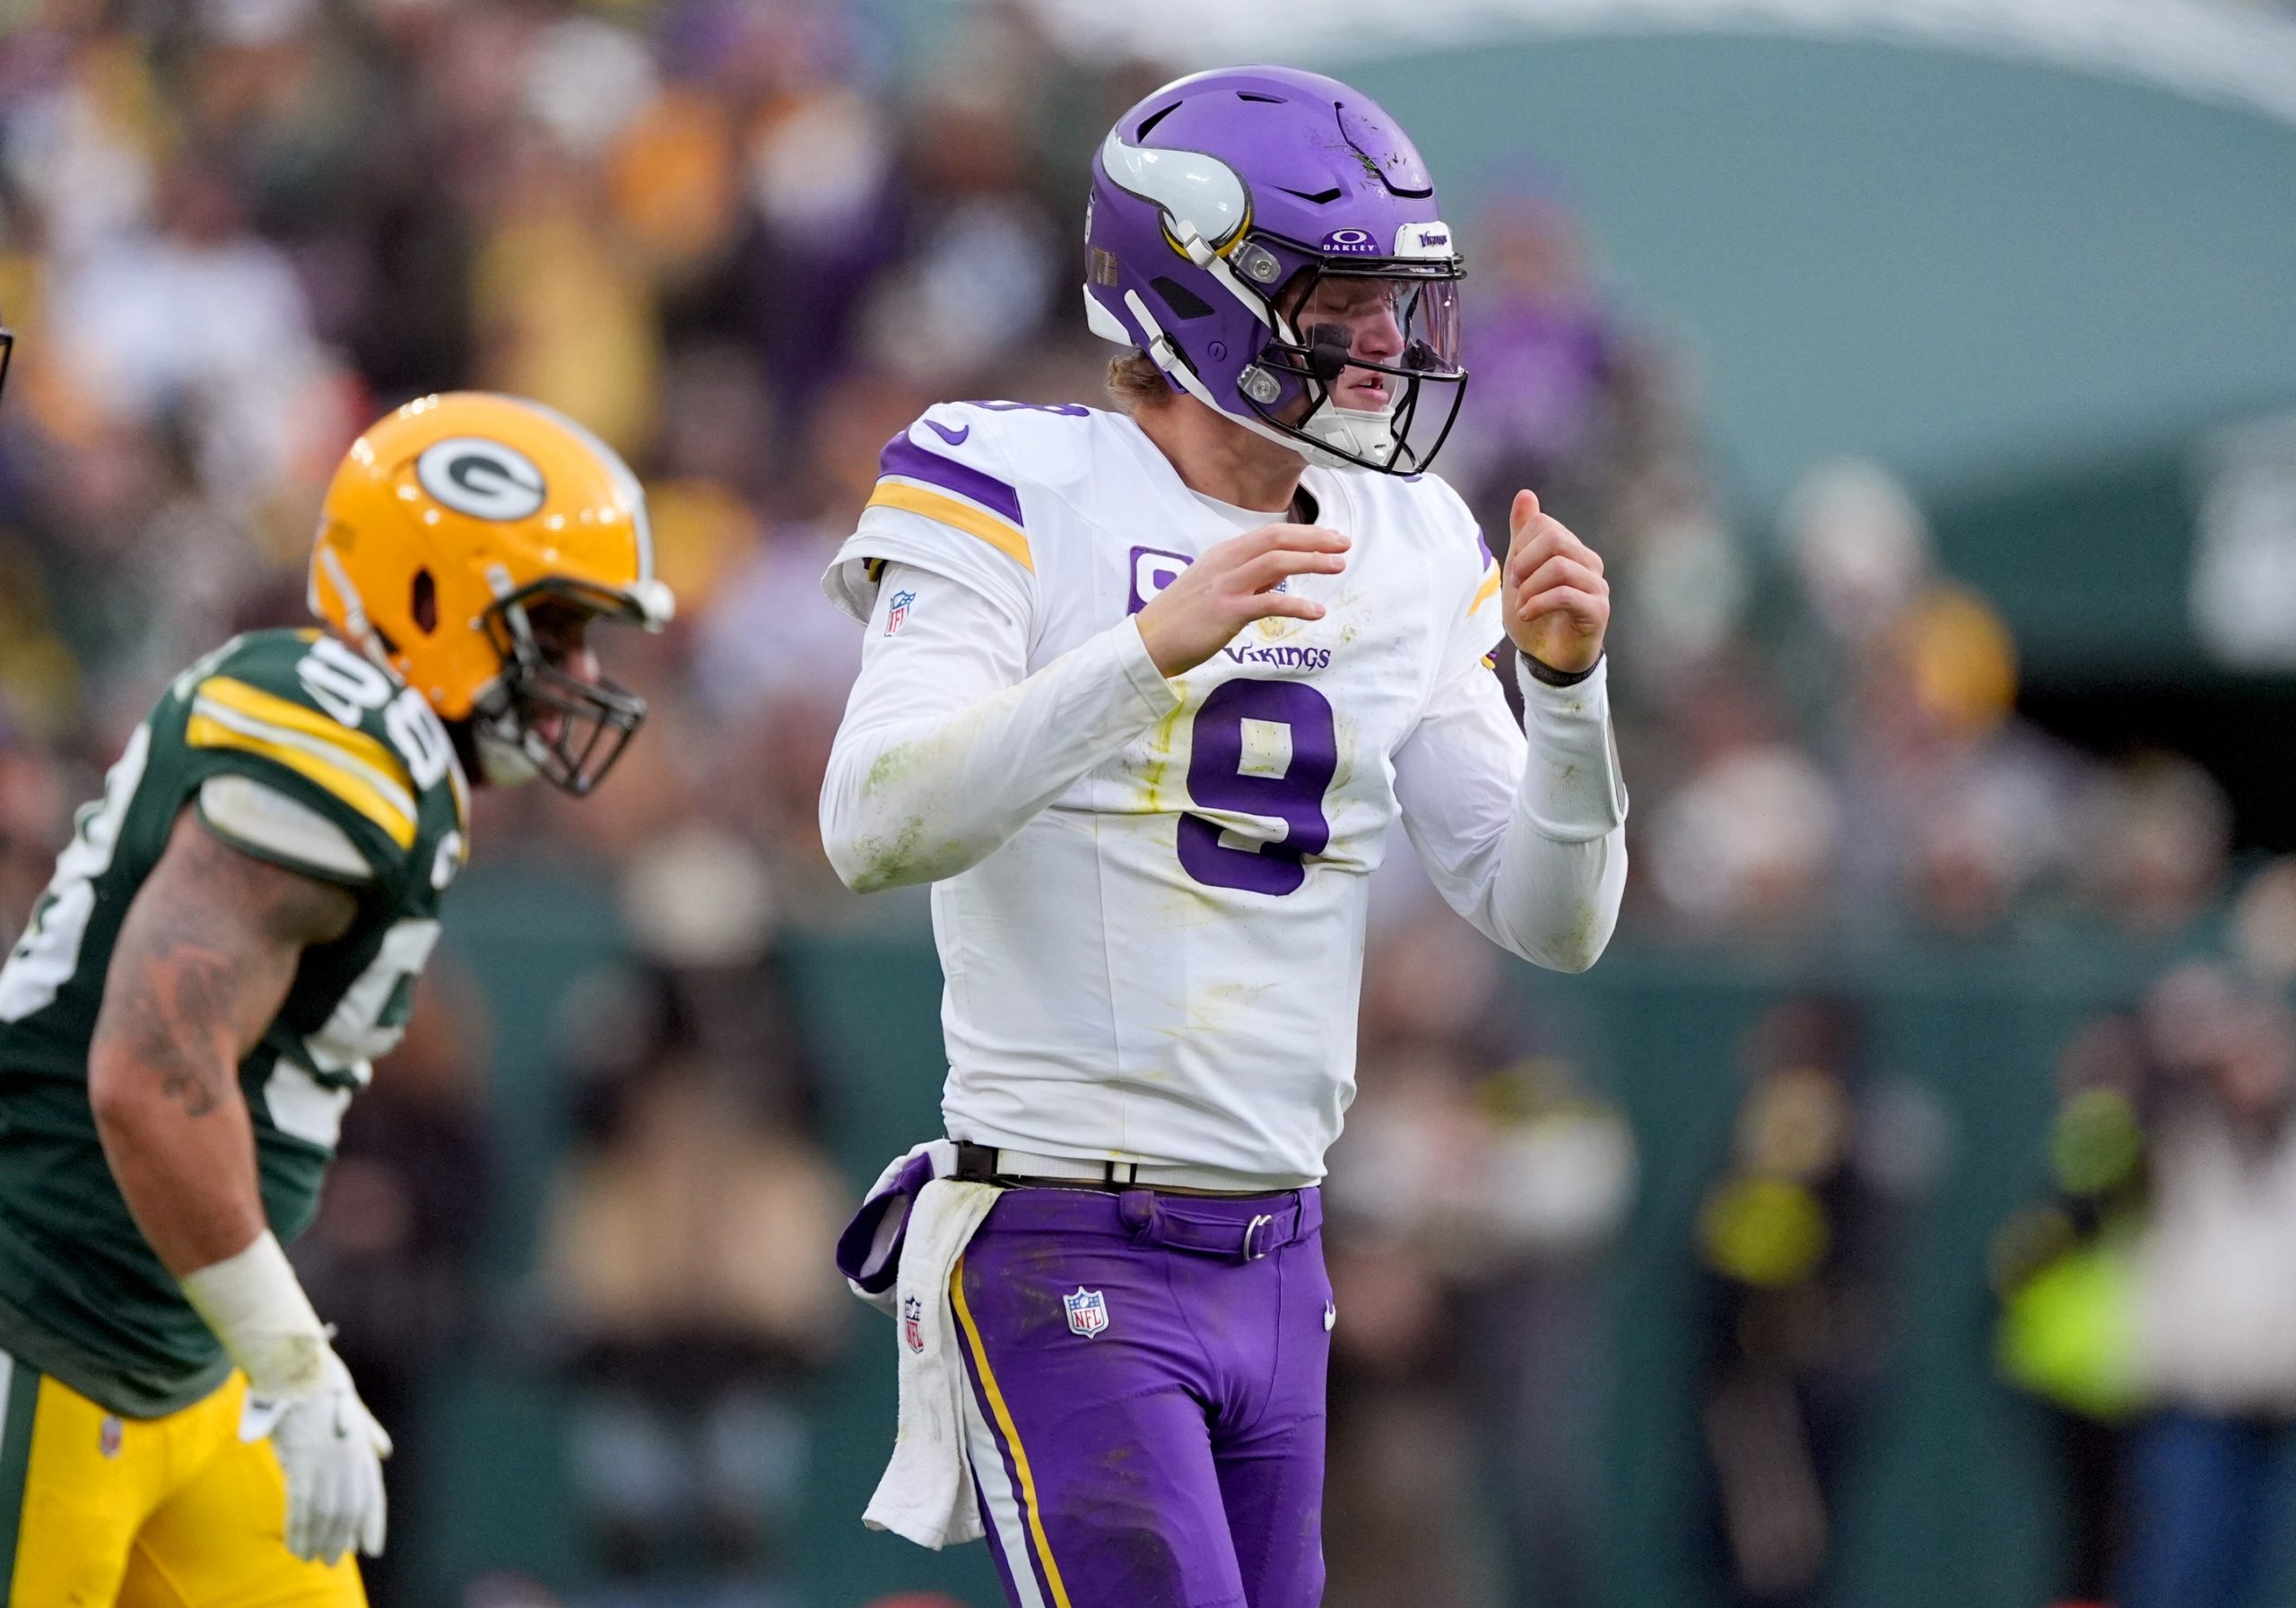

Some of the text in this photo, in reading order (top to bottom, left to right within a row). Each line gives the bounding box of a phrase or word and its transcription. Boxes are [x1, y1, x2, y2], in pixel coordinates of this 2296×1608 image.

[1323, 243, 1376, 252] OAKLEY
[417, 436, 547, 521] G
[1222, 641, 1332, 672] VIKINGS
[1177, 677, 1338, 897] 9
[1074, 1309, 1102, 1329] NFL
